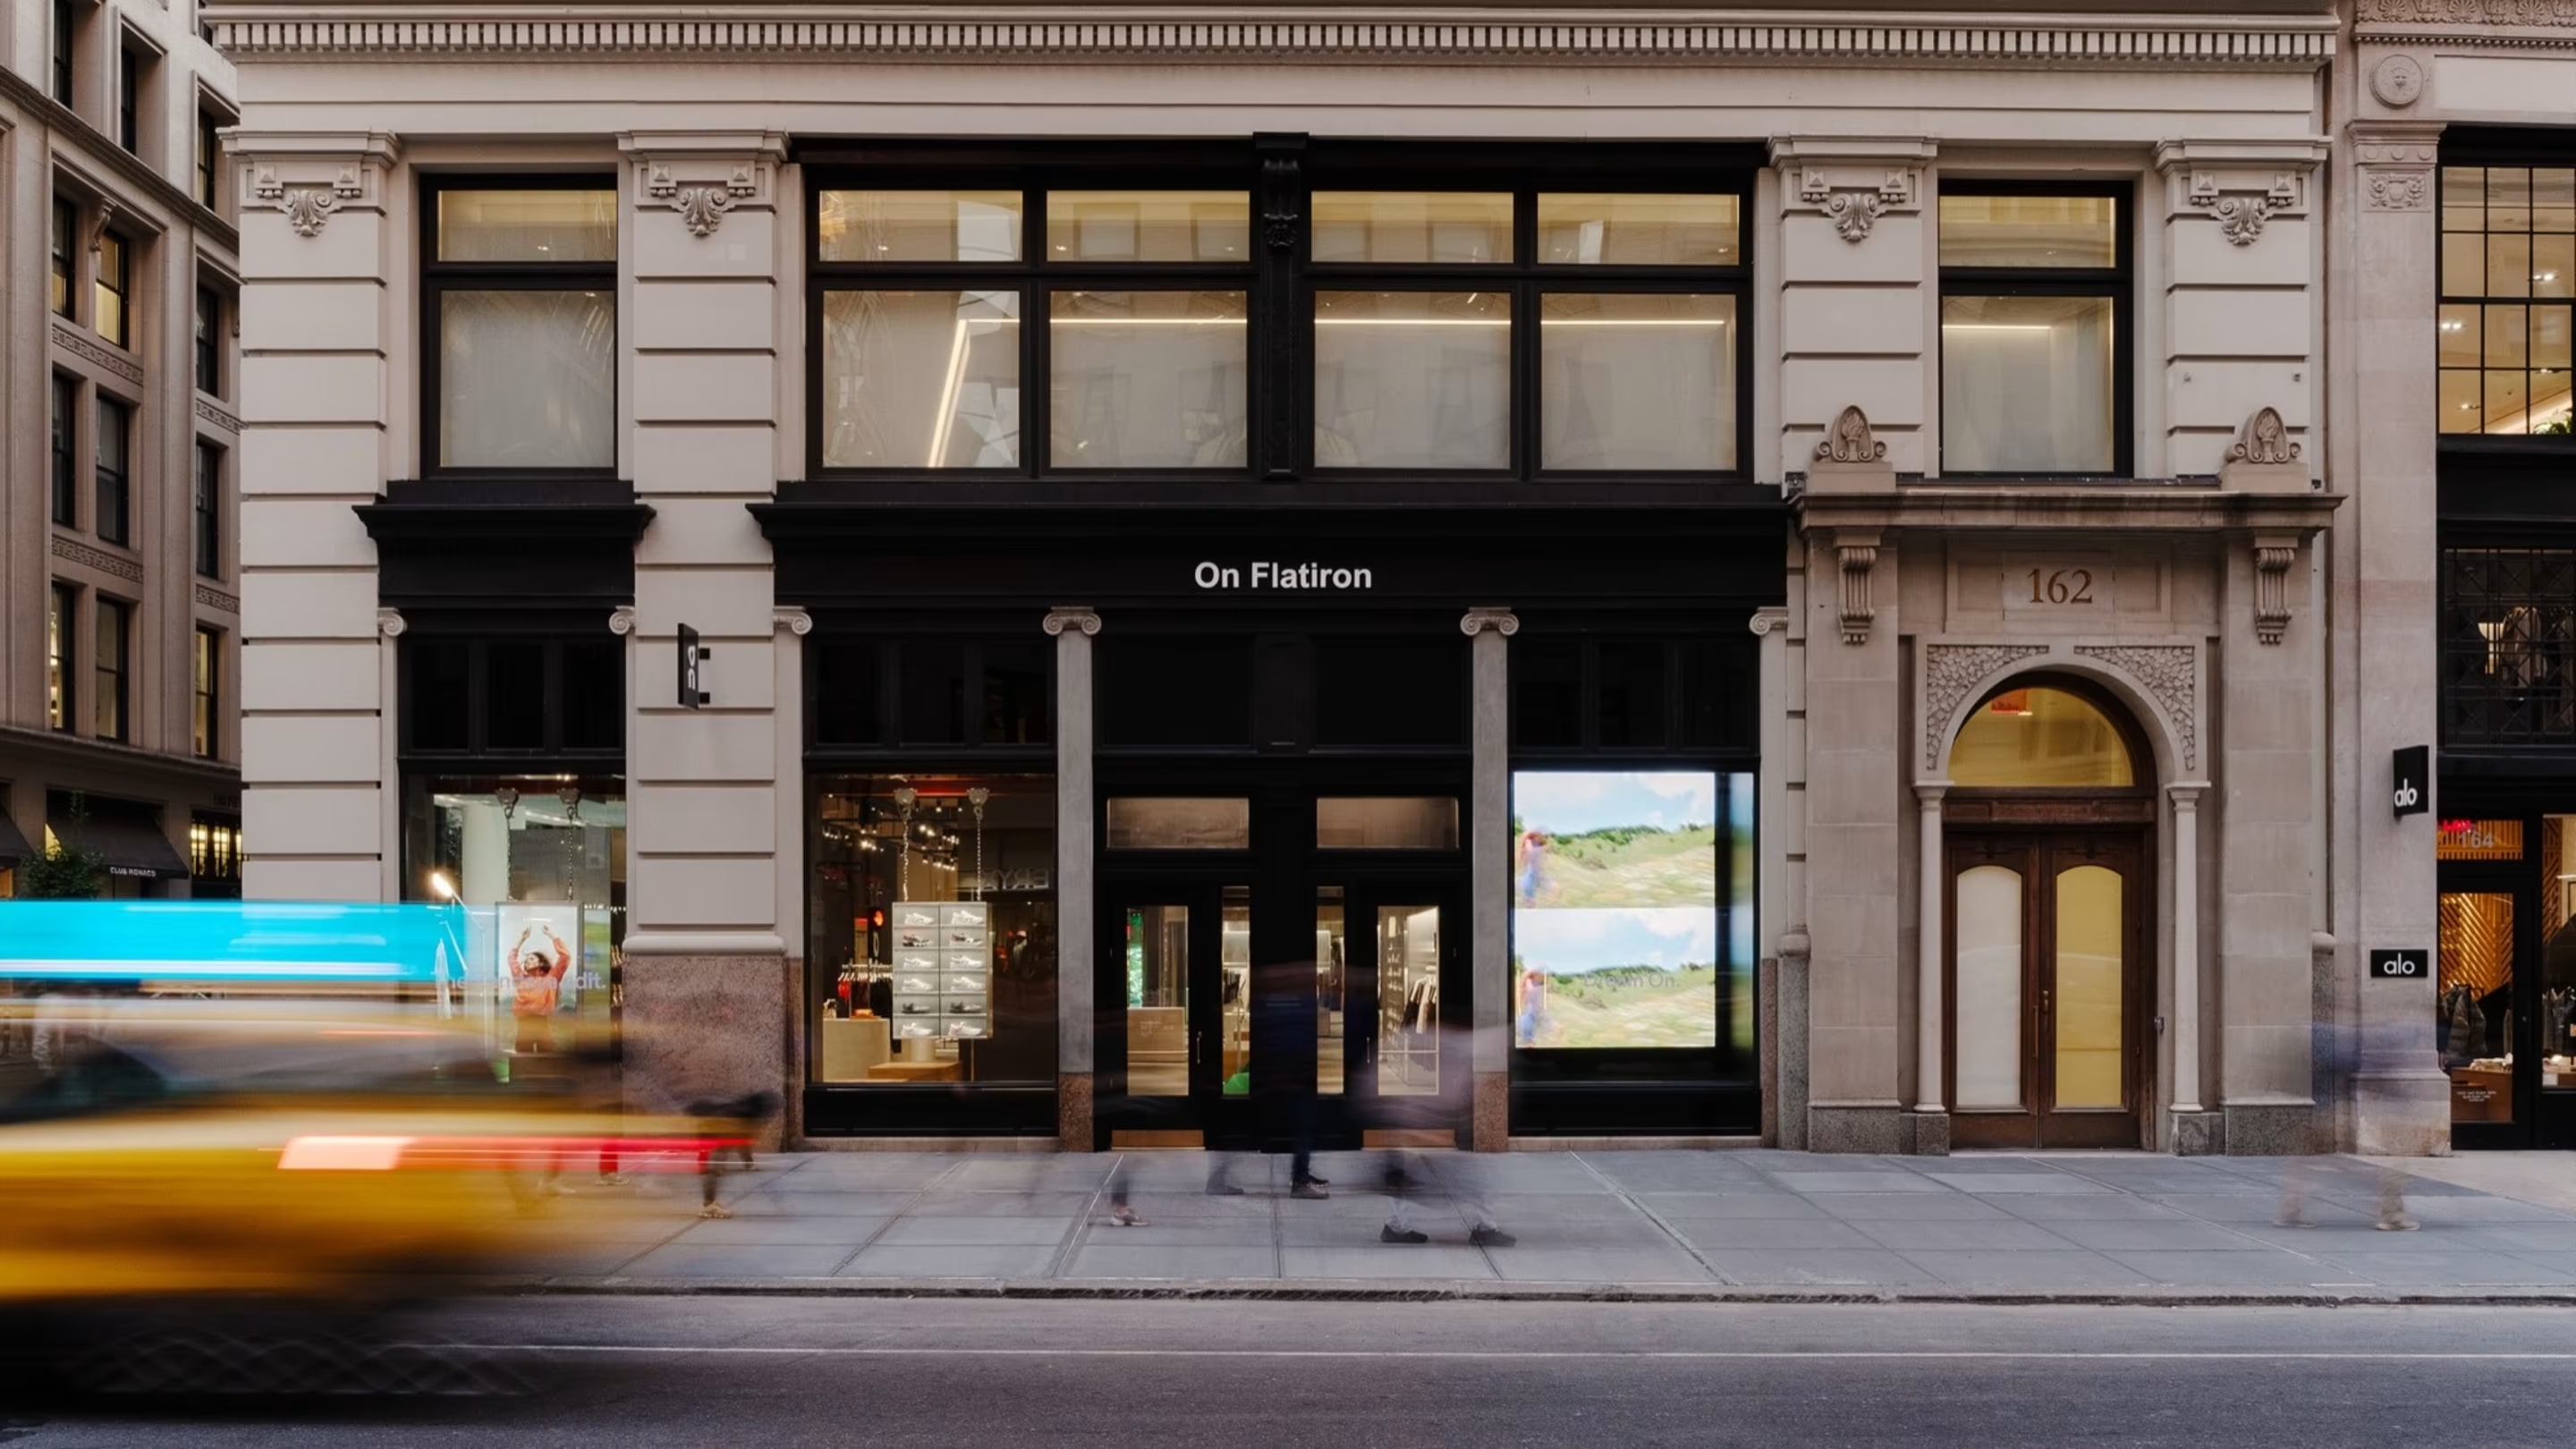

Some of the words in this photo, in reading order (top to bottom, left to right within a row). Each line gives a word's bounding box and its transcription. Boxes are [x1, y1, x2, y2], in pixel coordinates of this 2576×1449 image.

[1194, 561, 1240, 589] On
[1251, 562, 1372, 589] Flatiron
[2027, 568, 2093, 604] 162
[2394, 777, 2418, 807] alo
[2461, 830, 2494, 848] 164
[109, 866, 127, 876] CLUB
[128, 868, 157, 877] MONACO
[2383, 952, 2415, 975] alo
